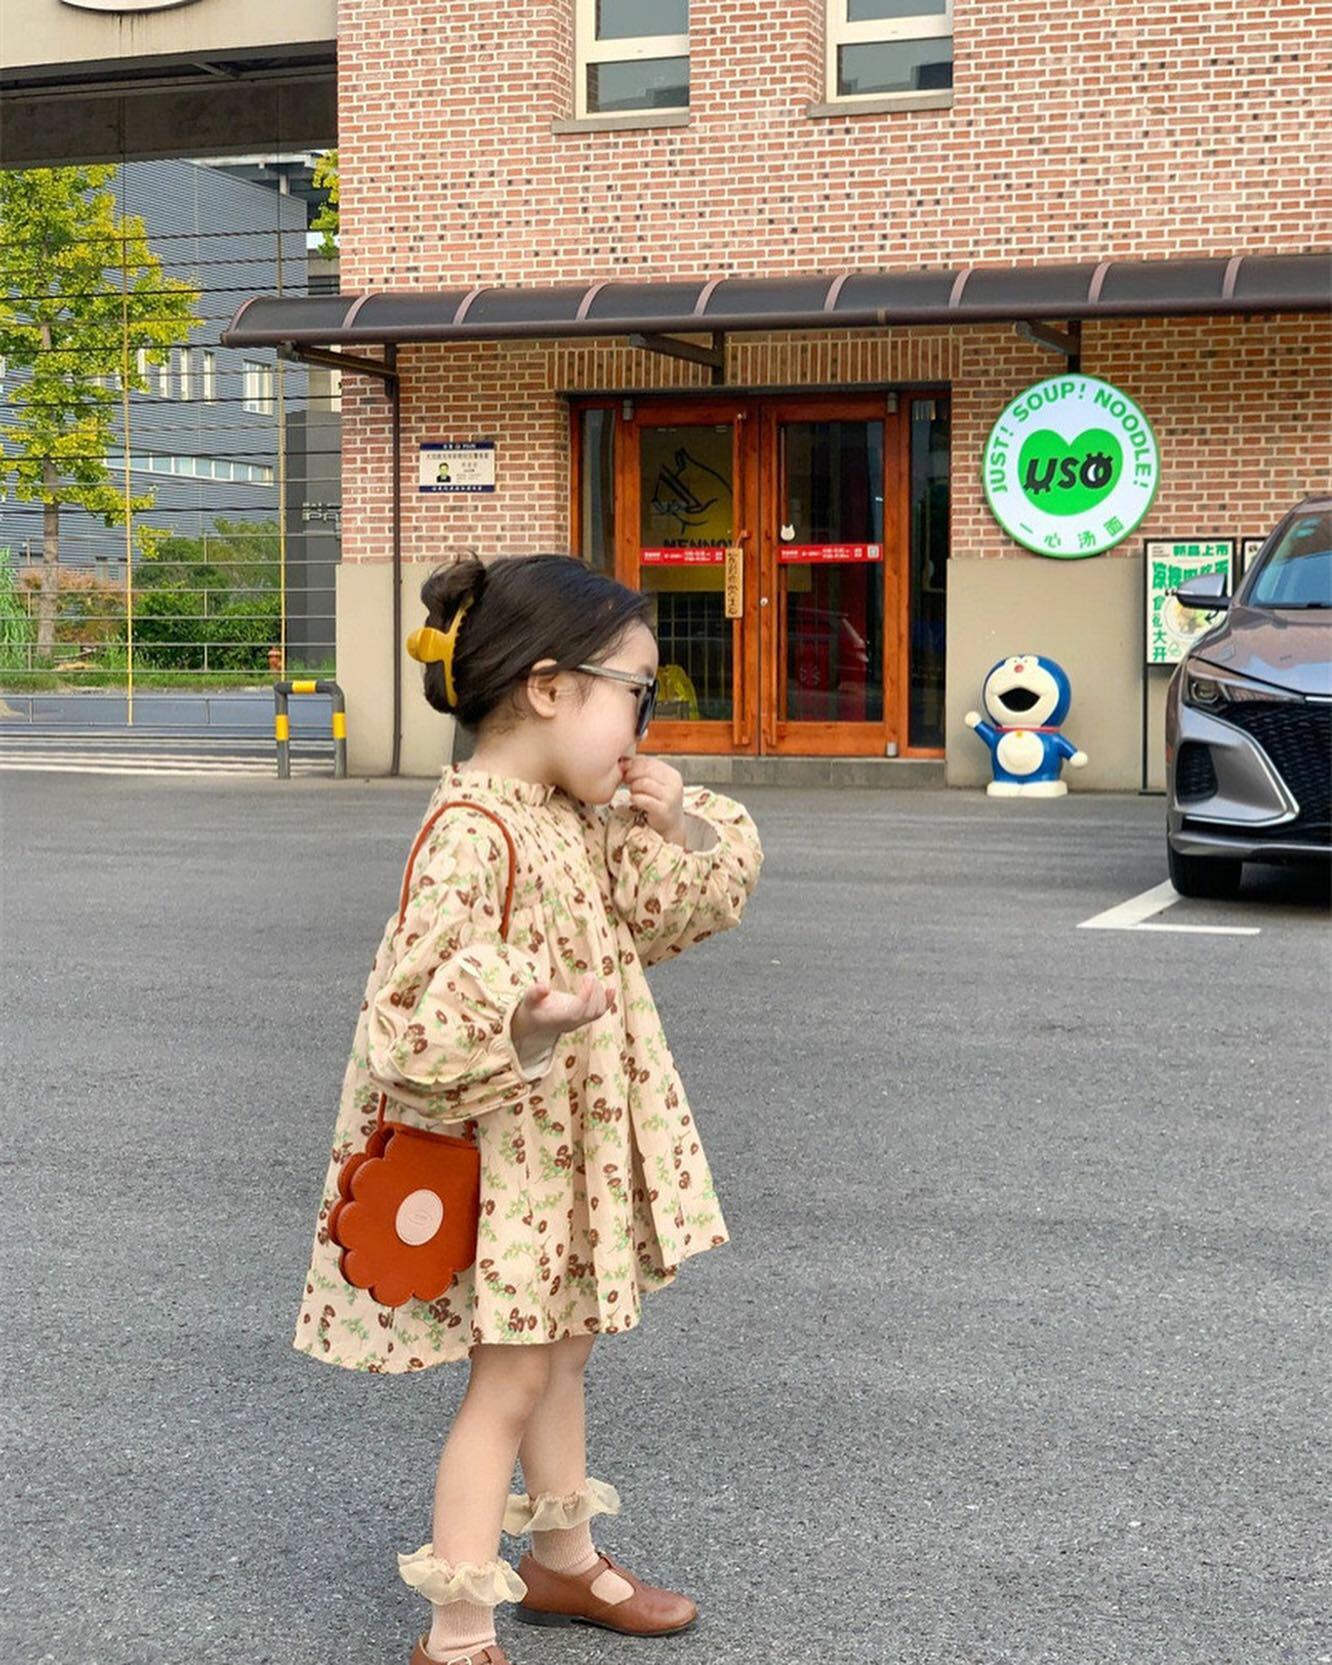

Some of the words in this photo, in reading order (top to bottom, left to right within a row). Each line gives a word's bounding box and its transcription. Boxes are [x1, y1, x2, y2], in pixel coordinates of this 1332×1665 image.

[990, 426, 1014, 492] JUST!
[1013, 382, 1086, 422] SOUP!
[1094, 389, 1151, 489] NOODLE!
[1024, 452, 1113, 495] USO
[1019, 516, 1124, 549] 一心汤面
[1173, 545, 1229, 557] 新品上市
